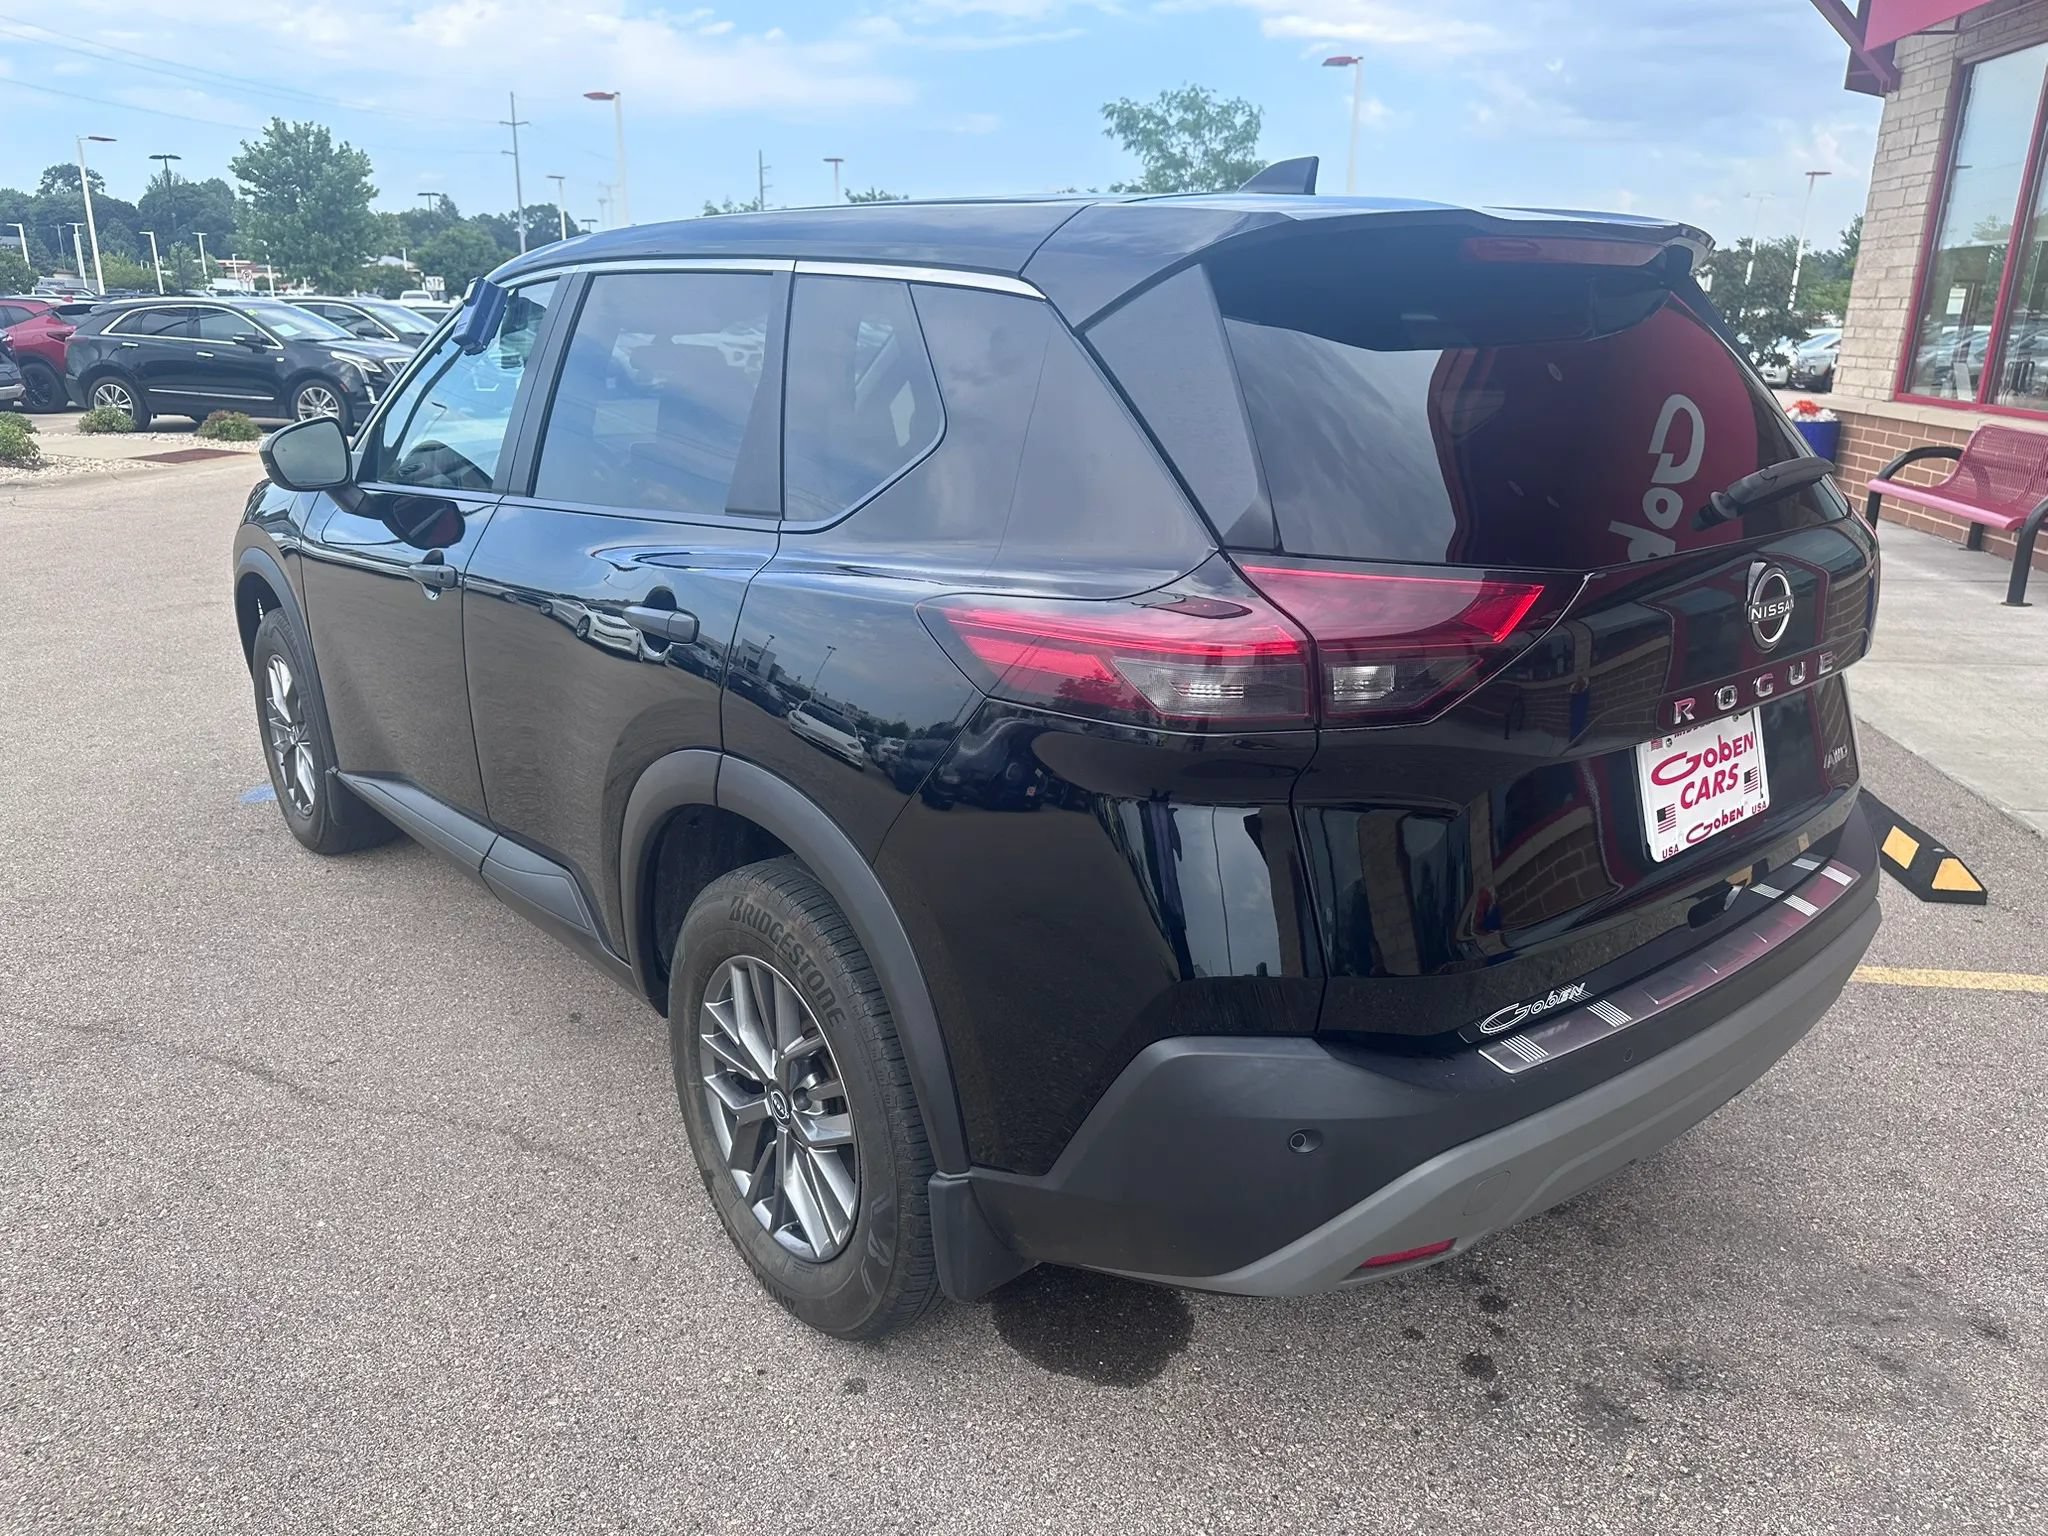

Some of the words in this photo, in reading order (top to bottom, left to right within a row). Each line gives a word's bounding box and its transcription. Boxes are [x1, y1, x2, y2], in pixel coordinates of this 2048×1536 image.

[1750, 599, 1794, 620] NISSAN
[1673, 650, 1834, 725] ROGUE
[1680, 763, 1740, 810] CARS
[1751, 800, 1767, 815] USA
[1662, 844, 1679, 859] USA
[729, 895, 847, 1028] BRIDGESTONE
